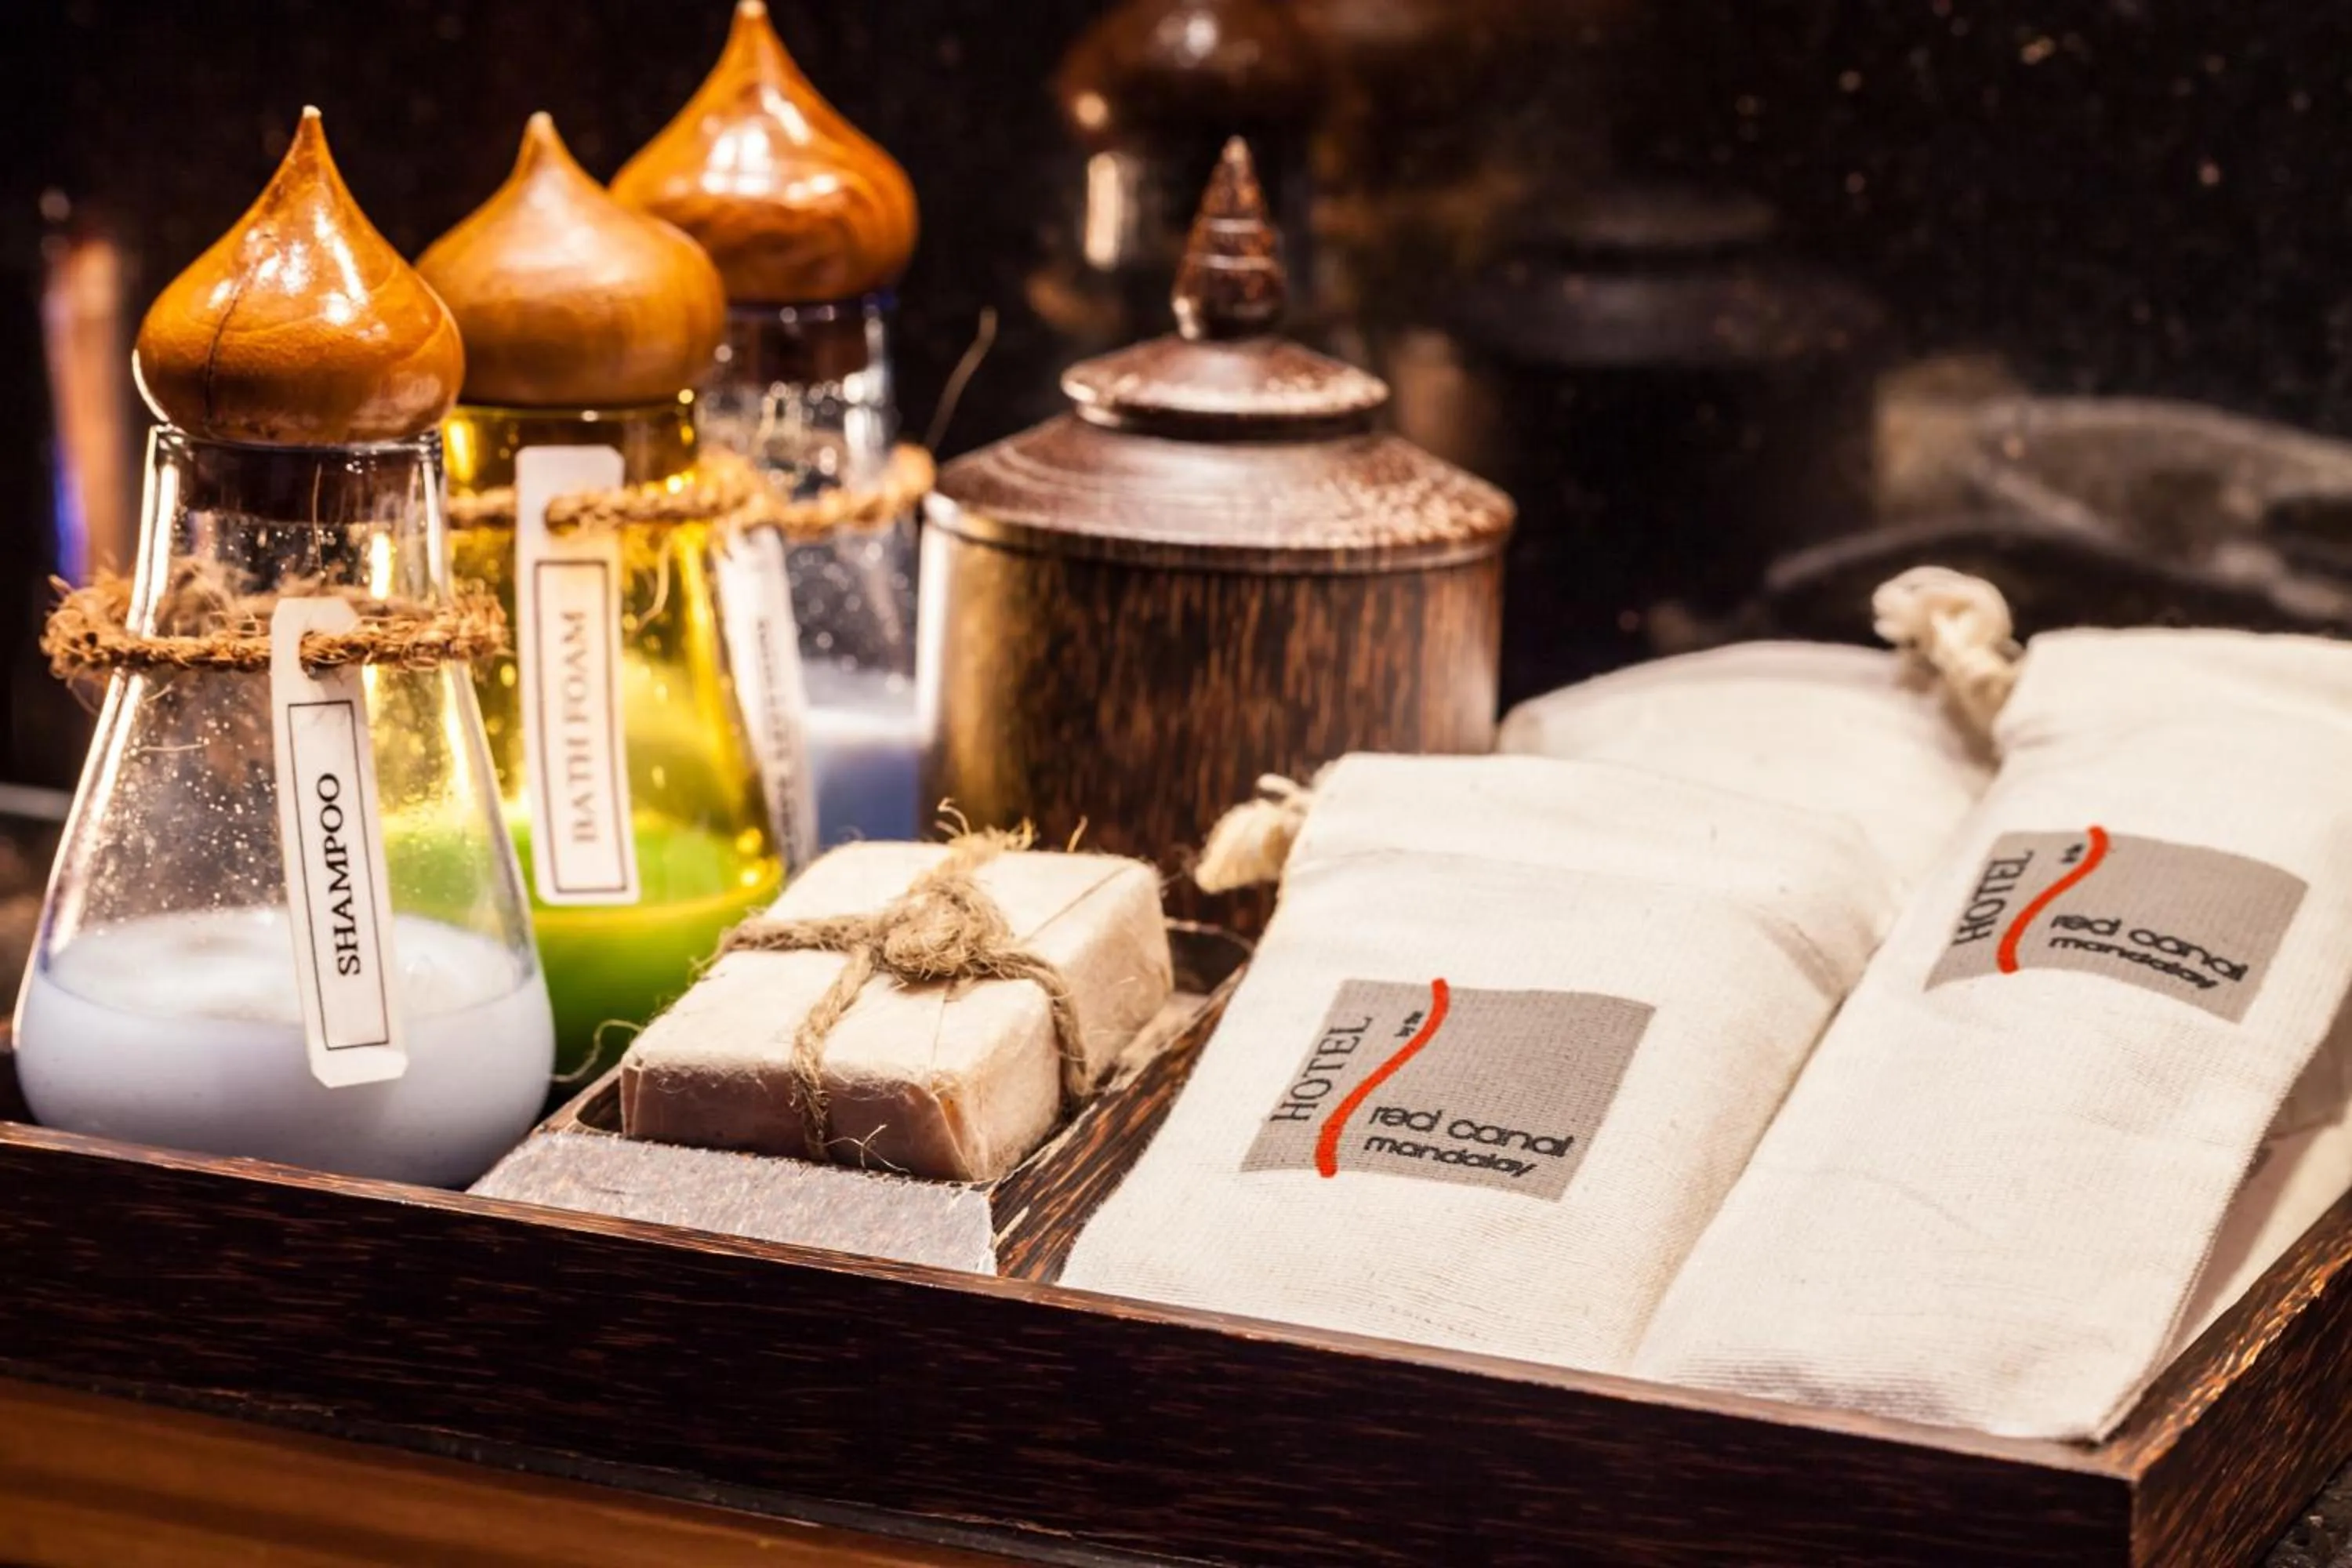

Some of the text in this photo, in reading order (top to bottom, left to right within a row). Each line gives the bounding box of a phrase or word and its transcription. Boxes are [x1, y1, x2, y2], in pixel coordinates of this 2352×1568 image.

[560, 611, 598, 844] BATH FOAM
[317, 772, 361, 976] SHAMPOO
[1952, 849, 2035, 946] HOTEL
[2049, 914, 2249, 982] red canal
[1269, 1016, 1374, 1122] HOTEL
[1363, 1135, 1538, 1178] mandalay
[1368, 1105, 1575, 1158] red canal
